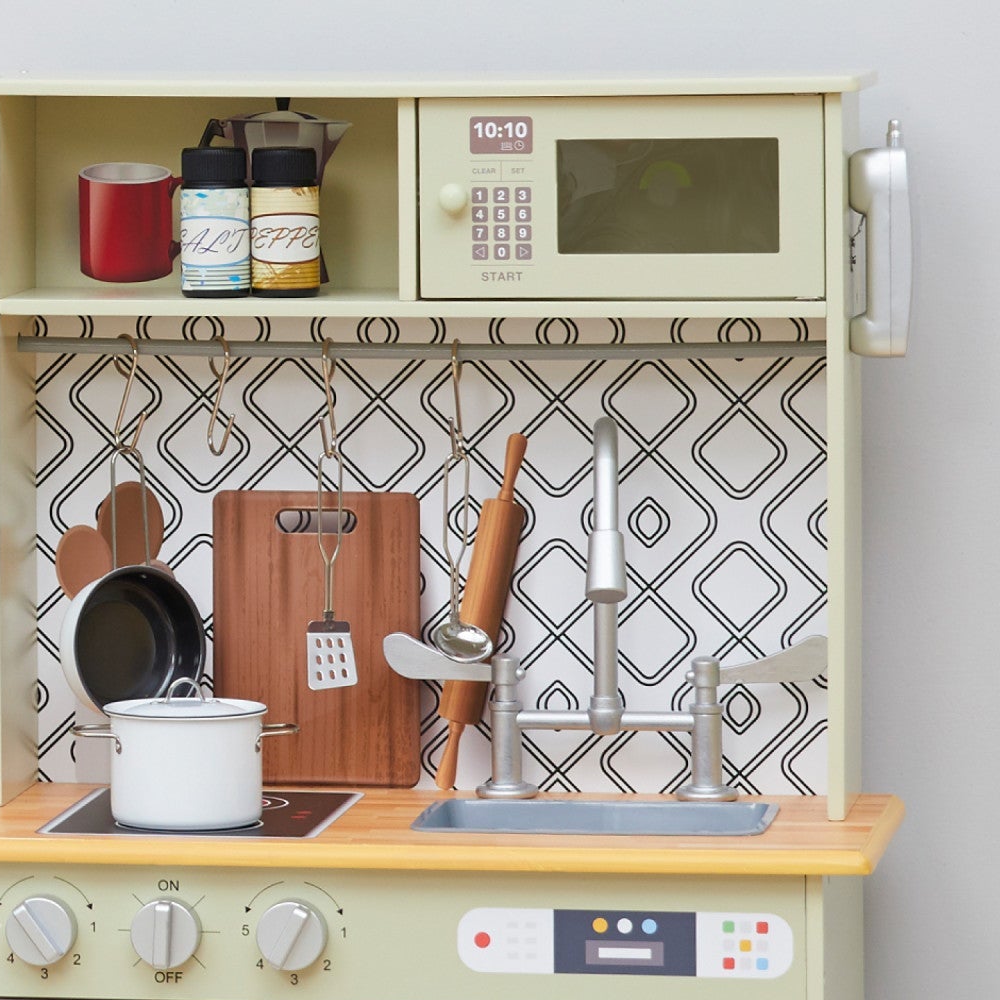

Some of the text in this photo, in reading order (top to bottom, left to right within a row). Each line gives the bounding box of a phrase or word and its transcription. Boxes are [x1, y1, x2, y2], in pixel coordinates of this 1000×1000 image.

[473, 122, 527, 138] 10:10
[476, 191, 526, 200] 1 2 3
[475, 210, 527, 219] 4 5 6
[251, 226, 319, 248] EPPE
[476, 228, 527, 238] 7 8 9
[498, 247, 505, 257] 0
[481, 272, 523, 282] START
[157, 879, 180, 892] ON
[90, 921, 96, 933] 1
[241, 924, 249, 937] 5
[340, 927, 347, 938] 1
[6, 952, 15, 965] 4
[73, 954, 81, 966] 2
[256, 958, 264, 970] 4
[323, 959, 331, 971] 2
[40, 968, 49, 980] 3
[154, 971, 183, 985] OFF
[290, 973, 299, 986] 3
